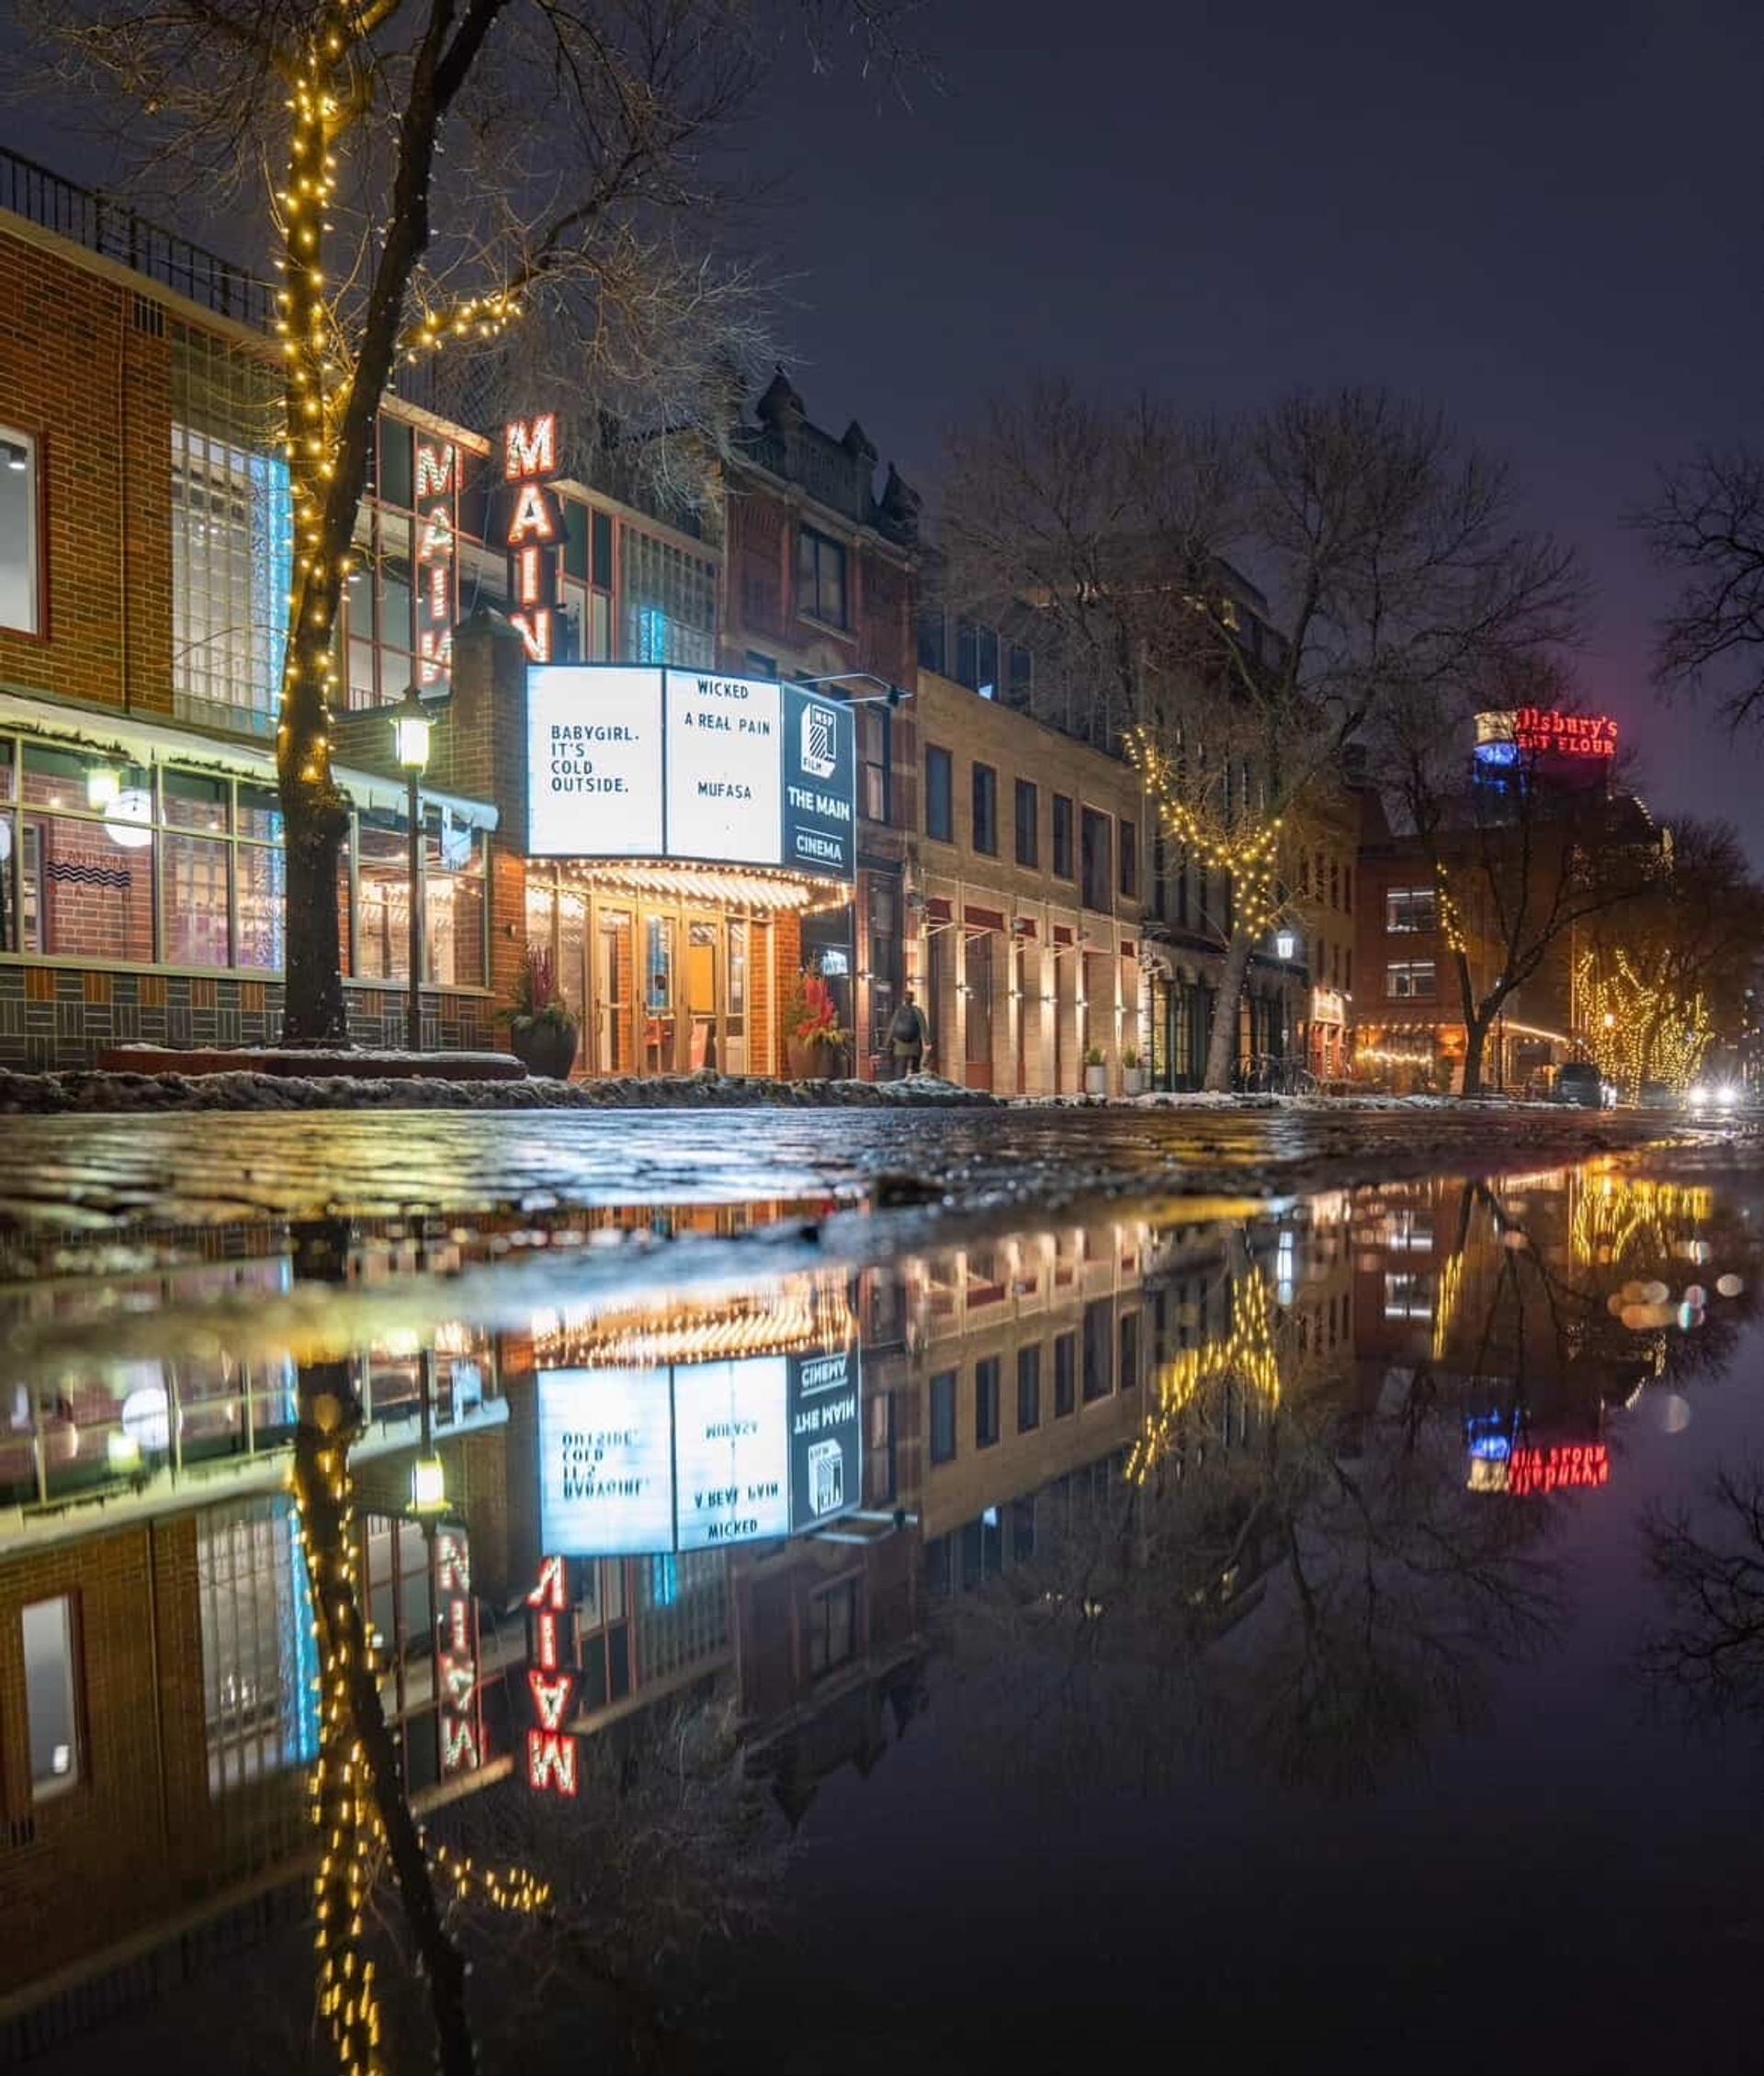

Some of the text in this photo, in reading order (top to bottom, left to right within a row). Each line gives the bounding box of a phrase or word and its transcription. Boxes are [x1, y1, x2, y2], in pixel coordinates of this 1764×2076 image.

[506, 412, 557, 663] MAIN
[696, 679, 749, 700] WICKED
[684, 713, 771, 736] A REAL PAIN
[1516, 707, 1618, 739] llsbury's
[551, 726, 640, 741] BABYGIRL.
[551, 742, 585, 758] IT'S
[551, 760, 594, 775] COLD
[803, 757, 822, 773] FILM
[551, 777, 629, 794] OUTSIDE.
[697, 782, 752, 800] MUFASA
[787, 786, 850, 821] THE MAIN
[796, 834, 842, 862] CINEMA
